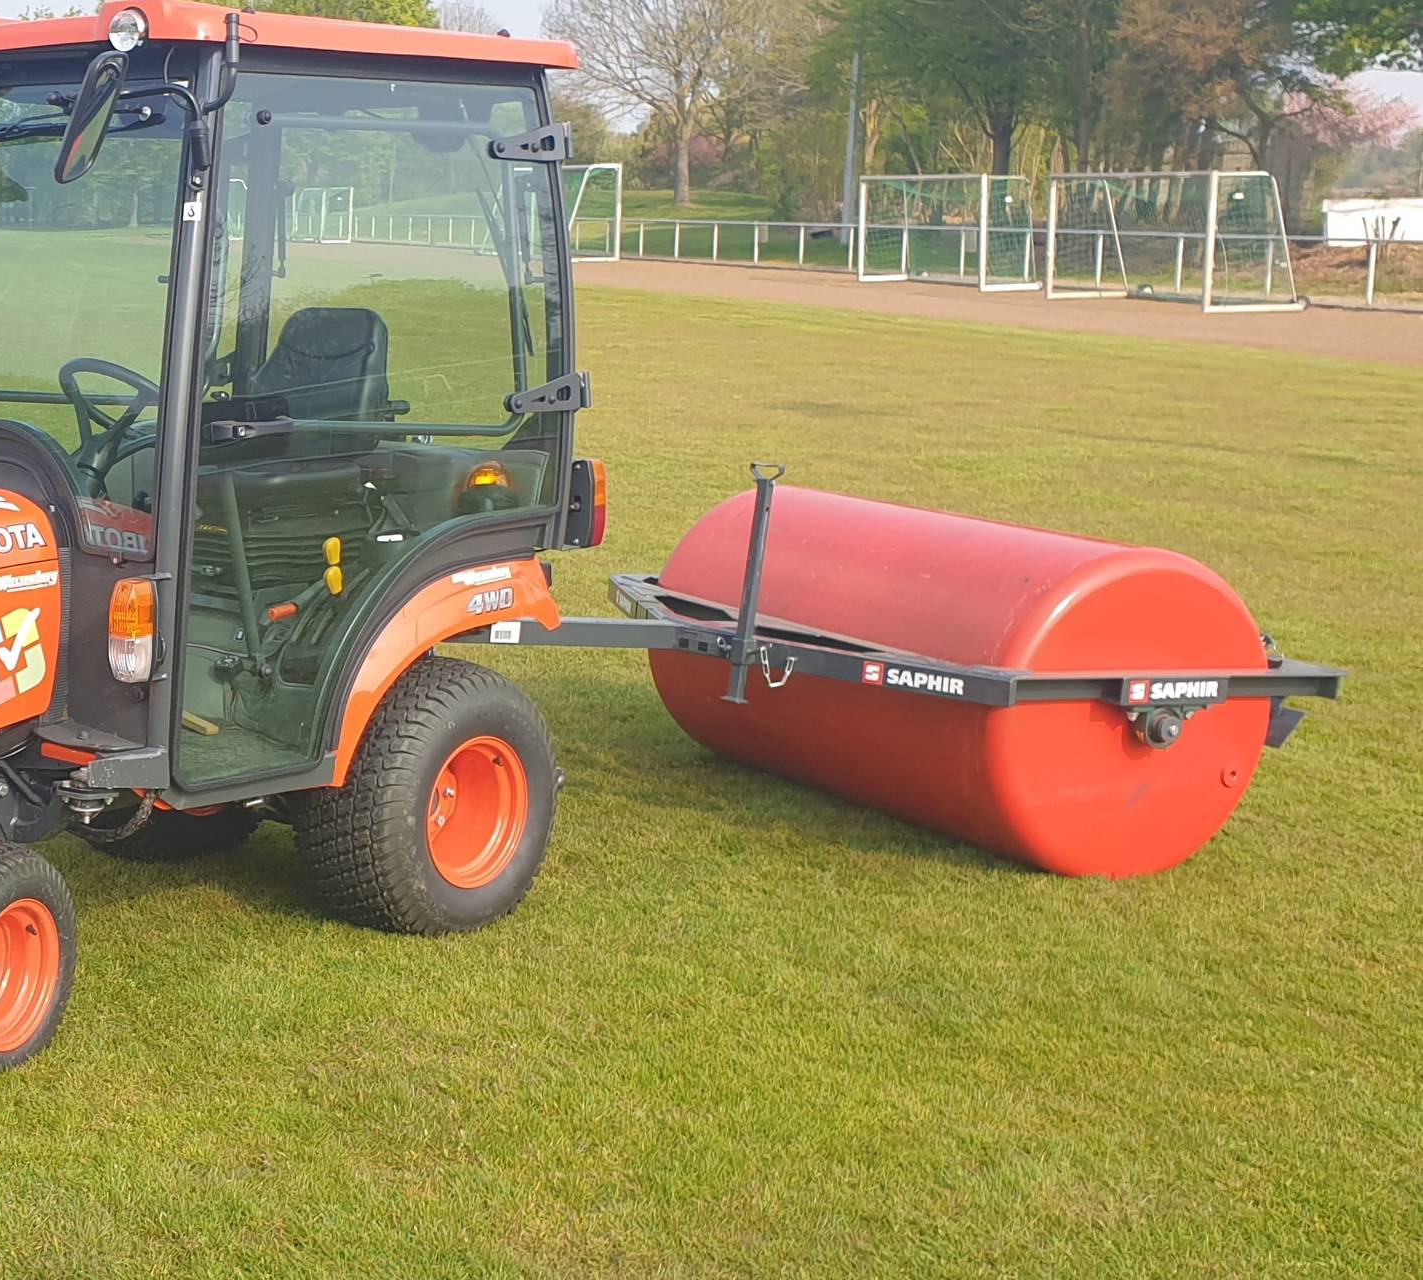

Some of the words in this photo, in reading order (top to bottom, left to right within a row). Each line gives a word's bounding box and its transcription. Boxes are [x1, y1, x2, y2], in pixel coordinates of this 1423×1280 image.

[466, 587, 514, 615] 4WD
[886, 668, 964, 696] SAPHIR
[1150, 681, 1218, 700] SAPHIR
